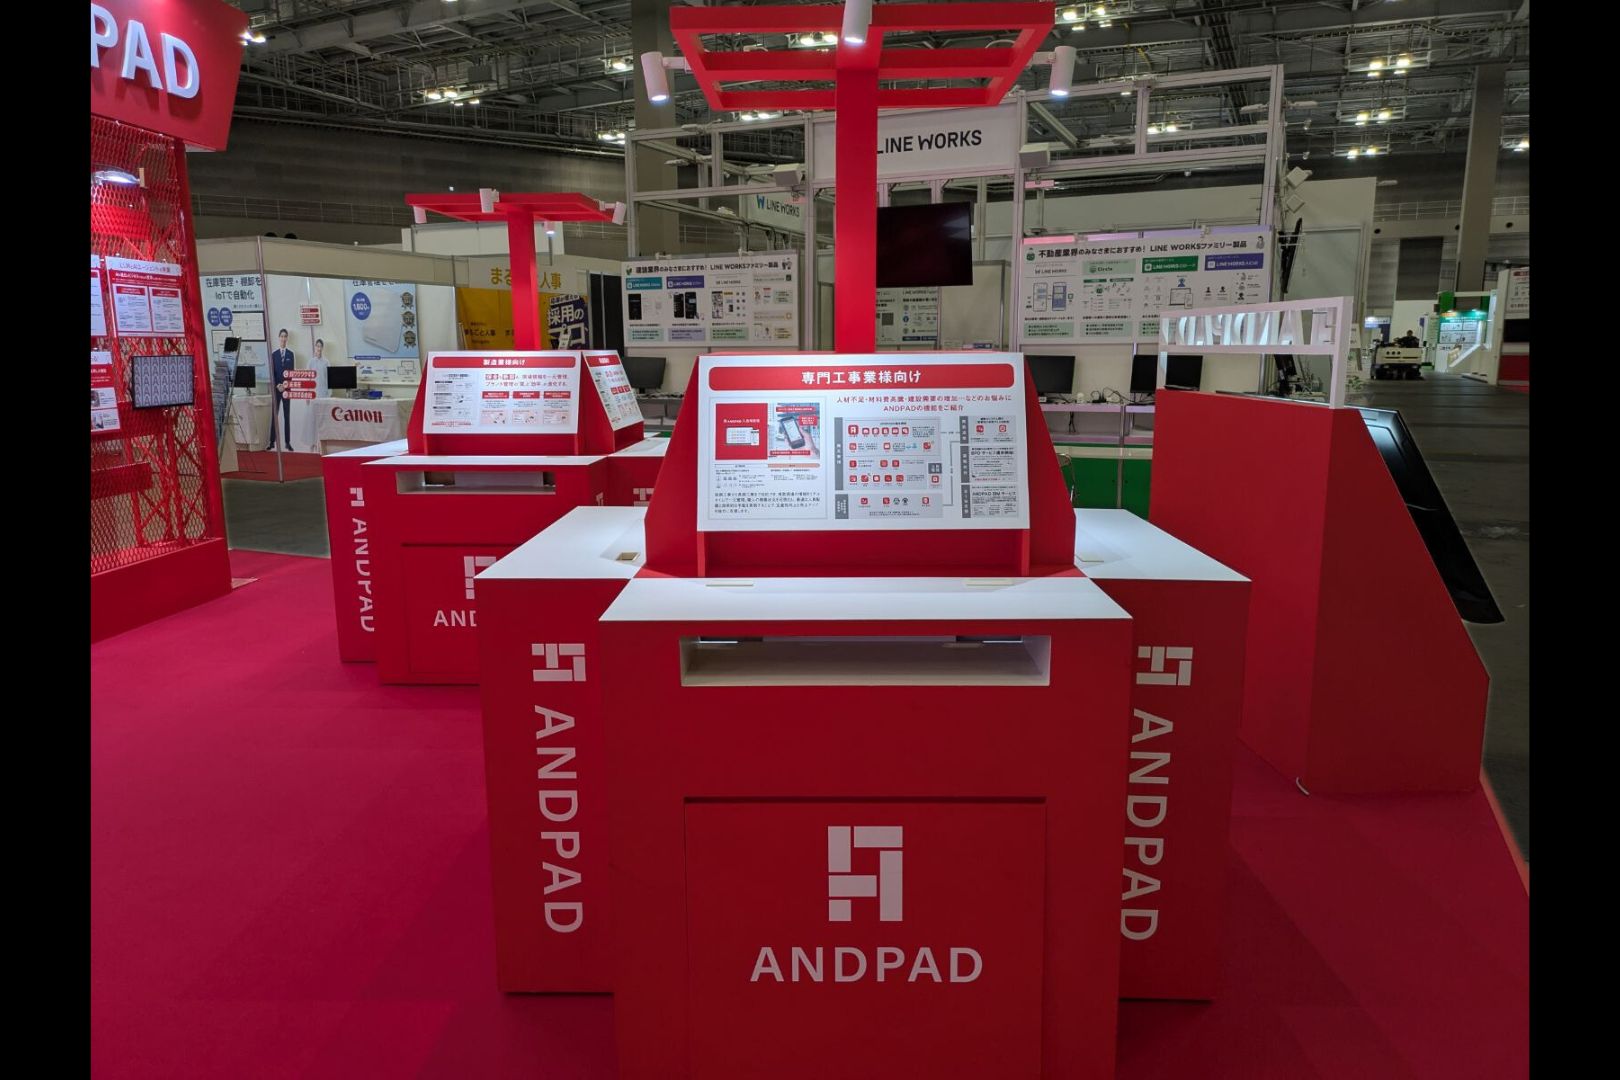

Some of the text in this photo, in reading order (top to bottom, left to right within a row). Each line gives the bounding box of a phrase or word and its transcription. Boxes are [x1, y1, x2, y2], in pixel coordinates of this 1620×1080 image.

[91, 3, 199, 98] PAD
[877, 130, 982, 154] INE WORKS
[767, 199, 780, 212] LINE
[781, 204, 800, 217] WORKS
[801, 370, 922, 384] 専門工事業様向け
[331, 406, 383, 423] Canon
[535, 705, 583, 933] ANDPAD
[1120, 708, 1174, 940] ANDPAD
[750, 947, 983, 982] ANDPAD
